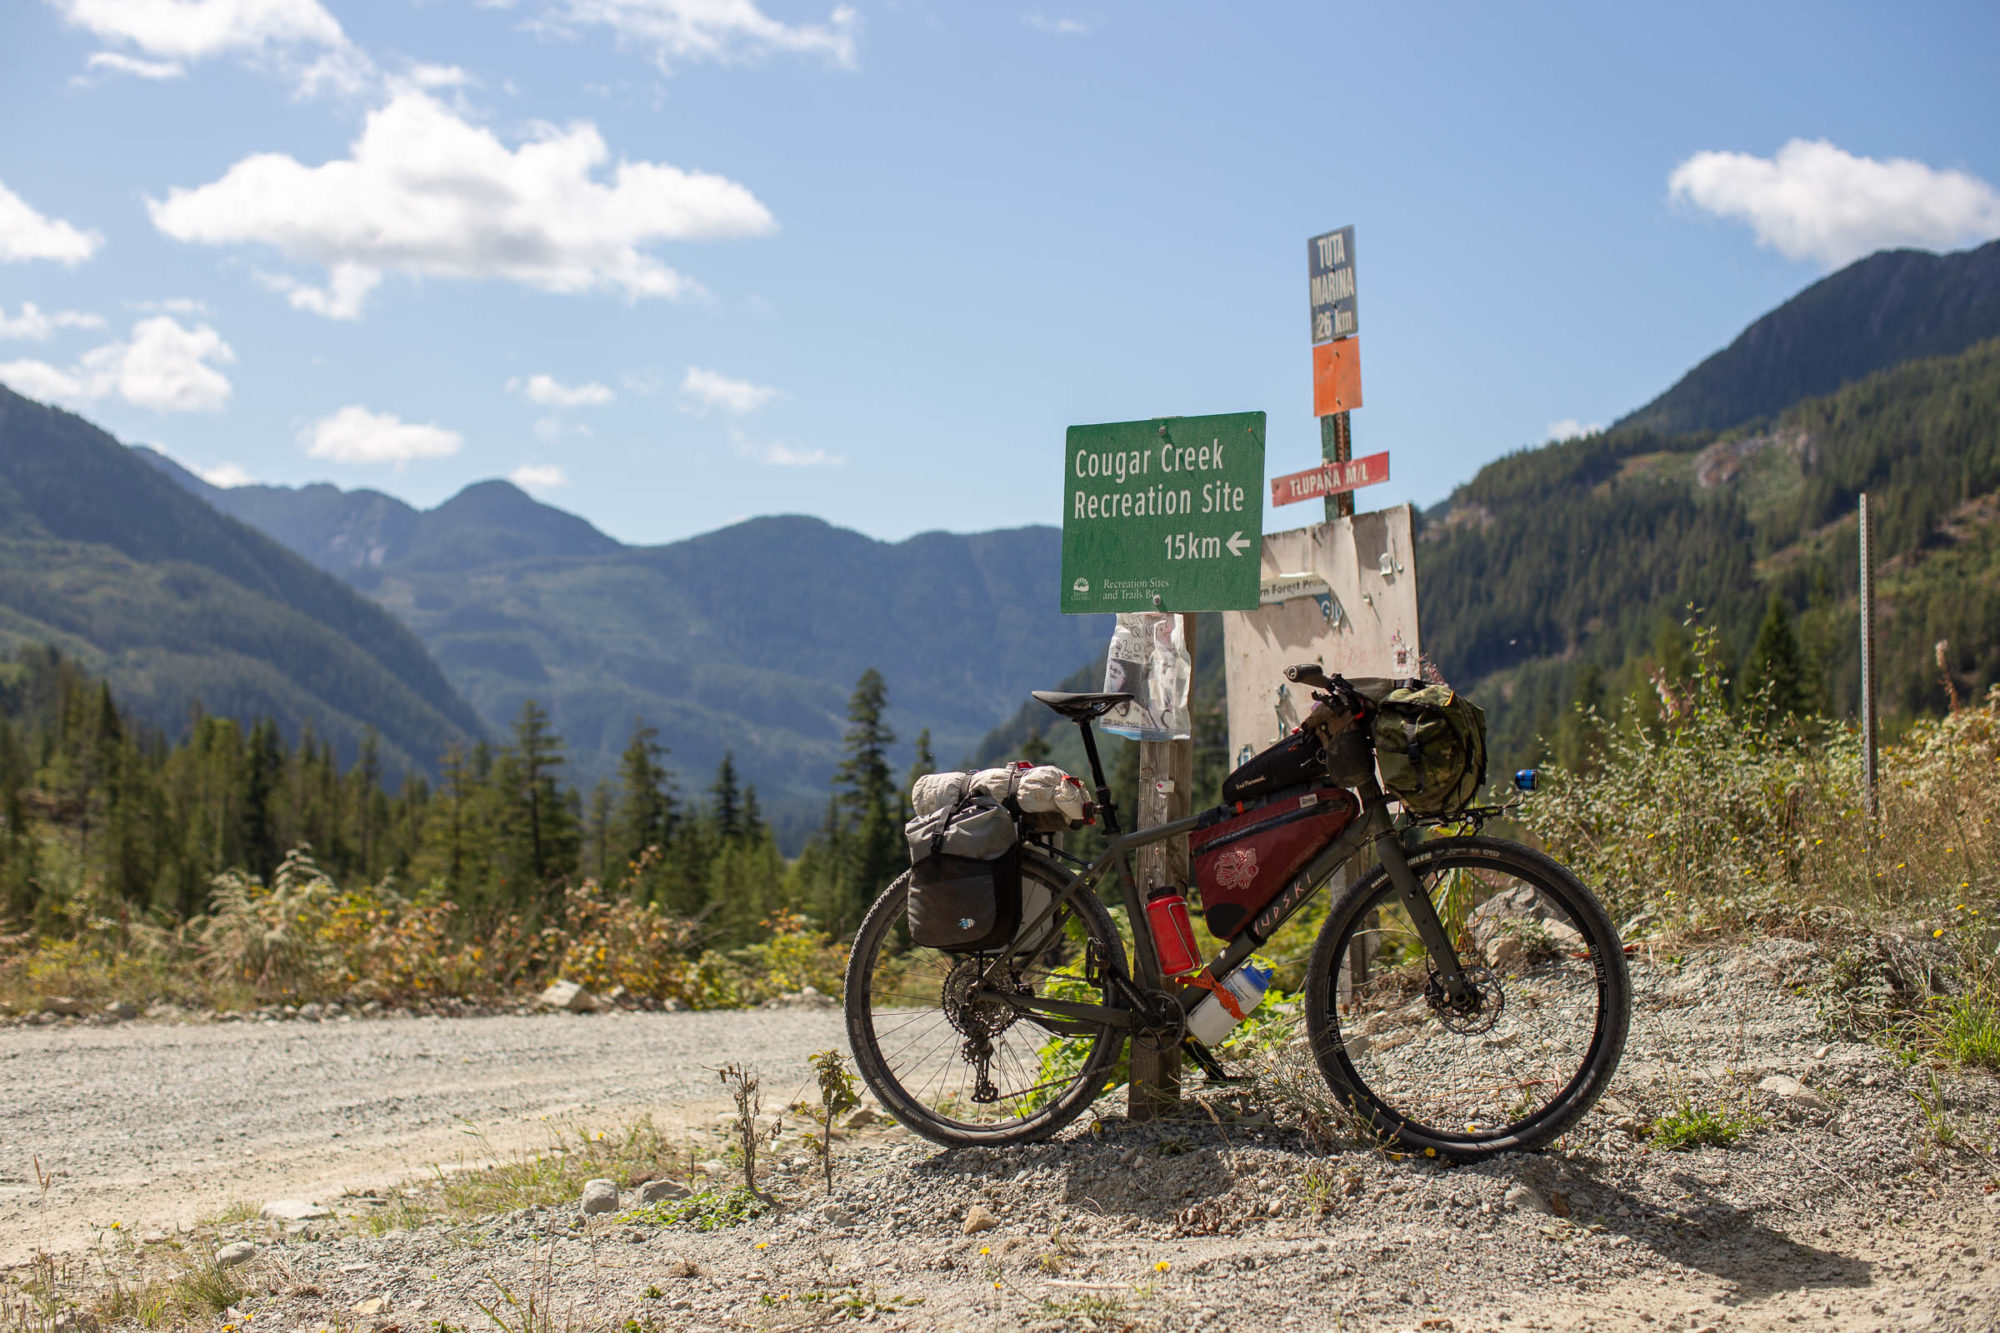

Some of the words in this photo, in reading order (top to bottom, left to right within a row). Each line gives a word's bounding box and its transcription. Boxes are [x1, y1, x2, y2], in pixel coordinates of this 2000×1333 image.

[1317, 232, 1345, 269] TUTA
[1311, 266, 1354, 306] MARINA
[1317, 311, 1332, 339] 26
[1335, 309, 1352, 334] km
[1075, 449, 1152, 484] Cougar
[1161, 438, 1224, 473] Creek
[1074, 483, 1191, 519] Recreation
[1202, 480, 1245, 514] Site
[1164, 532, 1221, 560] 15km
[1102, 589, 1118, 600] and
[1119, 588, 1143, 600] Trails
[1103, 578, 1148, 589] Recreation
[1149, 576, 1170, 588] Sites
[1272, 580, 1300, 595] Forest
